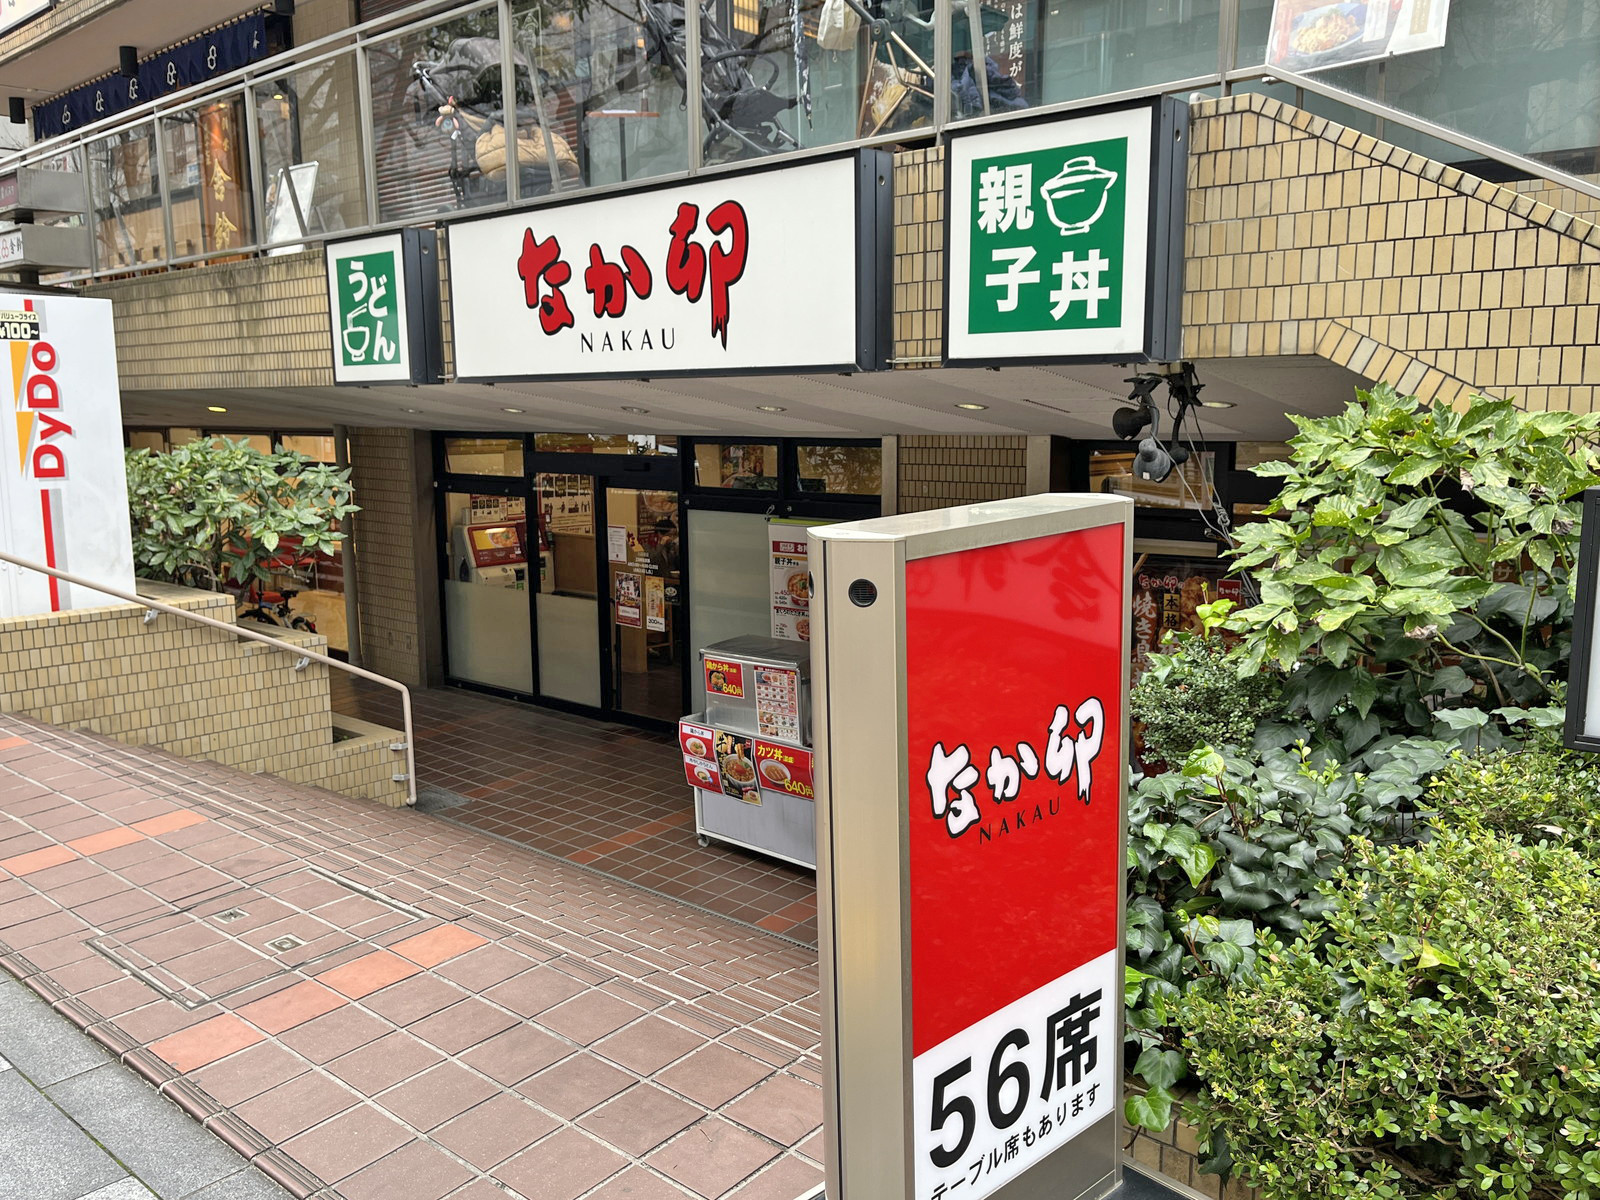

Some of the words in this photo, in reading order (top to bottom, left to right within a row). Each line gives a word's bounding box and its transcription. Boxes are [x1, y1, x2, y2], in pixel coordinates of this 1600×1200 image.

[1008, 3, 1024, 88] は鮮度が
[347, 260, 396, 363] うどん
[517, 199, 749, 351] なか卯
[580, 330, 676, 353] NAKAU
[26, 341, 73, 478] DyDo
[1164, 595, 1179, 627] 本格
[723, 683, 743, 696] 640円
[757, 744, 783, 762] カツ丼
[784, 778, 814, 798] 640円
[926, 696, 1105, 838] なか卯
[979, 796, 1062, 844] NAKAU
[929, 987, 1103, 1169] 56席
[931, 1083, 1101, 1200] テーブル席もあります
